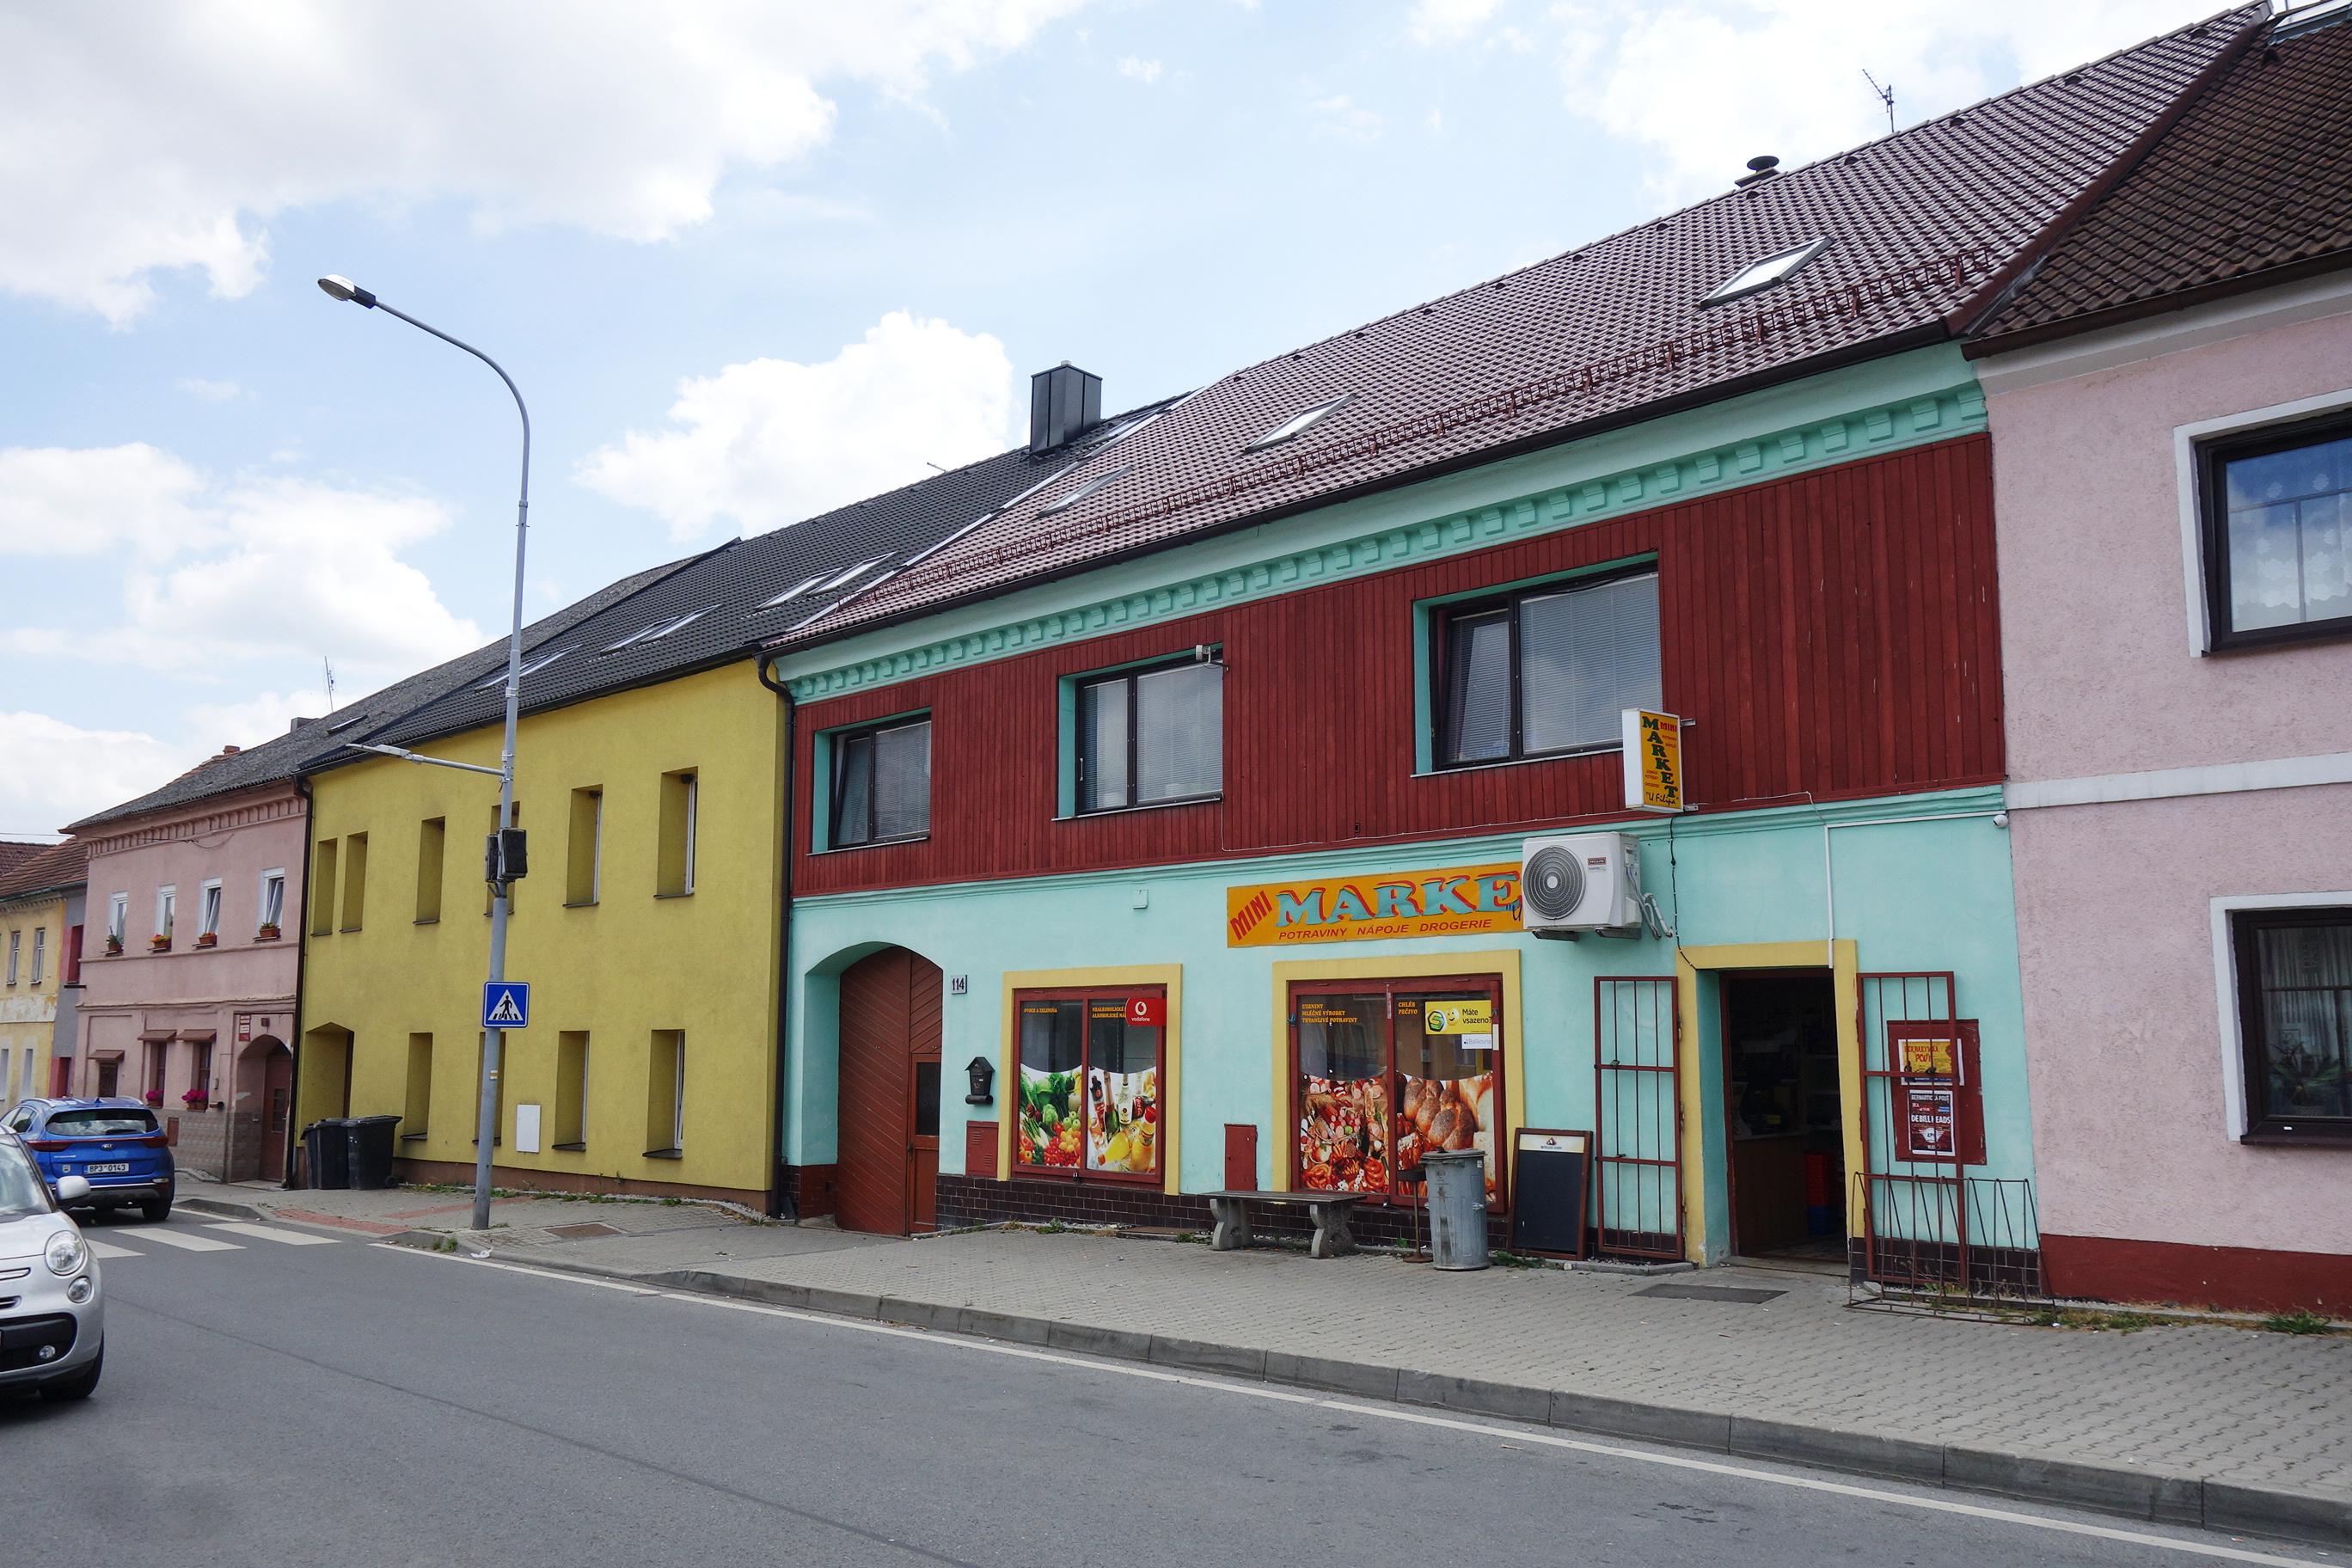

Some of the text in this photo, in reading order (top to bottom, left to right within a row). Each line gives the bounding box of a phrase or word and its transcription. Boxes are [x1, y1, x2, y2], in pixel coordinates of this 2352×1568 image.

[1660, 721, 1677, 732] MINI
[1641, 716, 1678, 798] MARKET
[1229, 890, 1273, 940] MINI
[1276, 870, 1523, 928] MARKE
[1278, 918, 1493, 940] POTRAVINY NÁPOJE DROGERIE
[952, 977, 965, 991] 114
